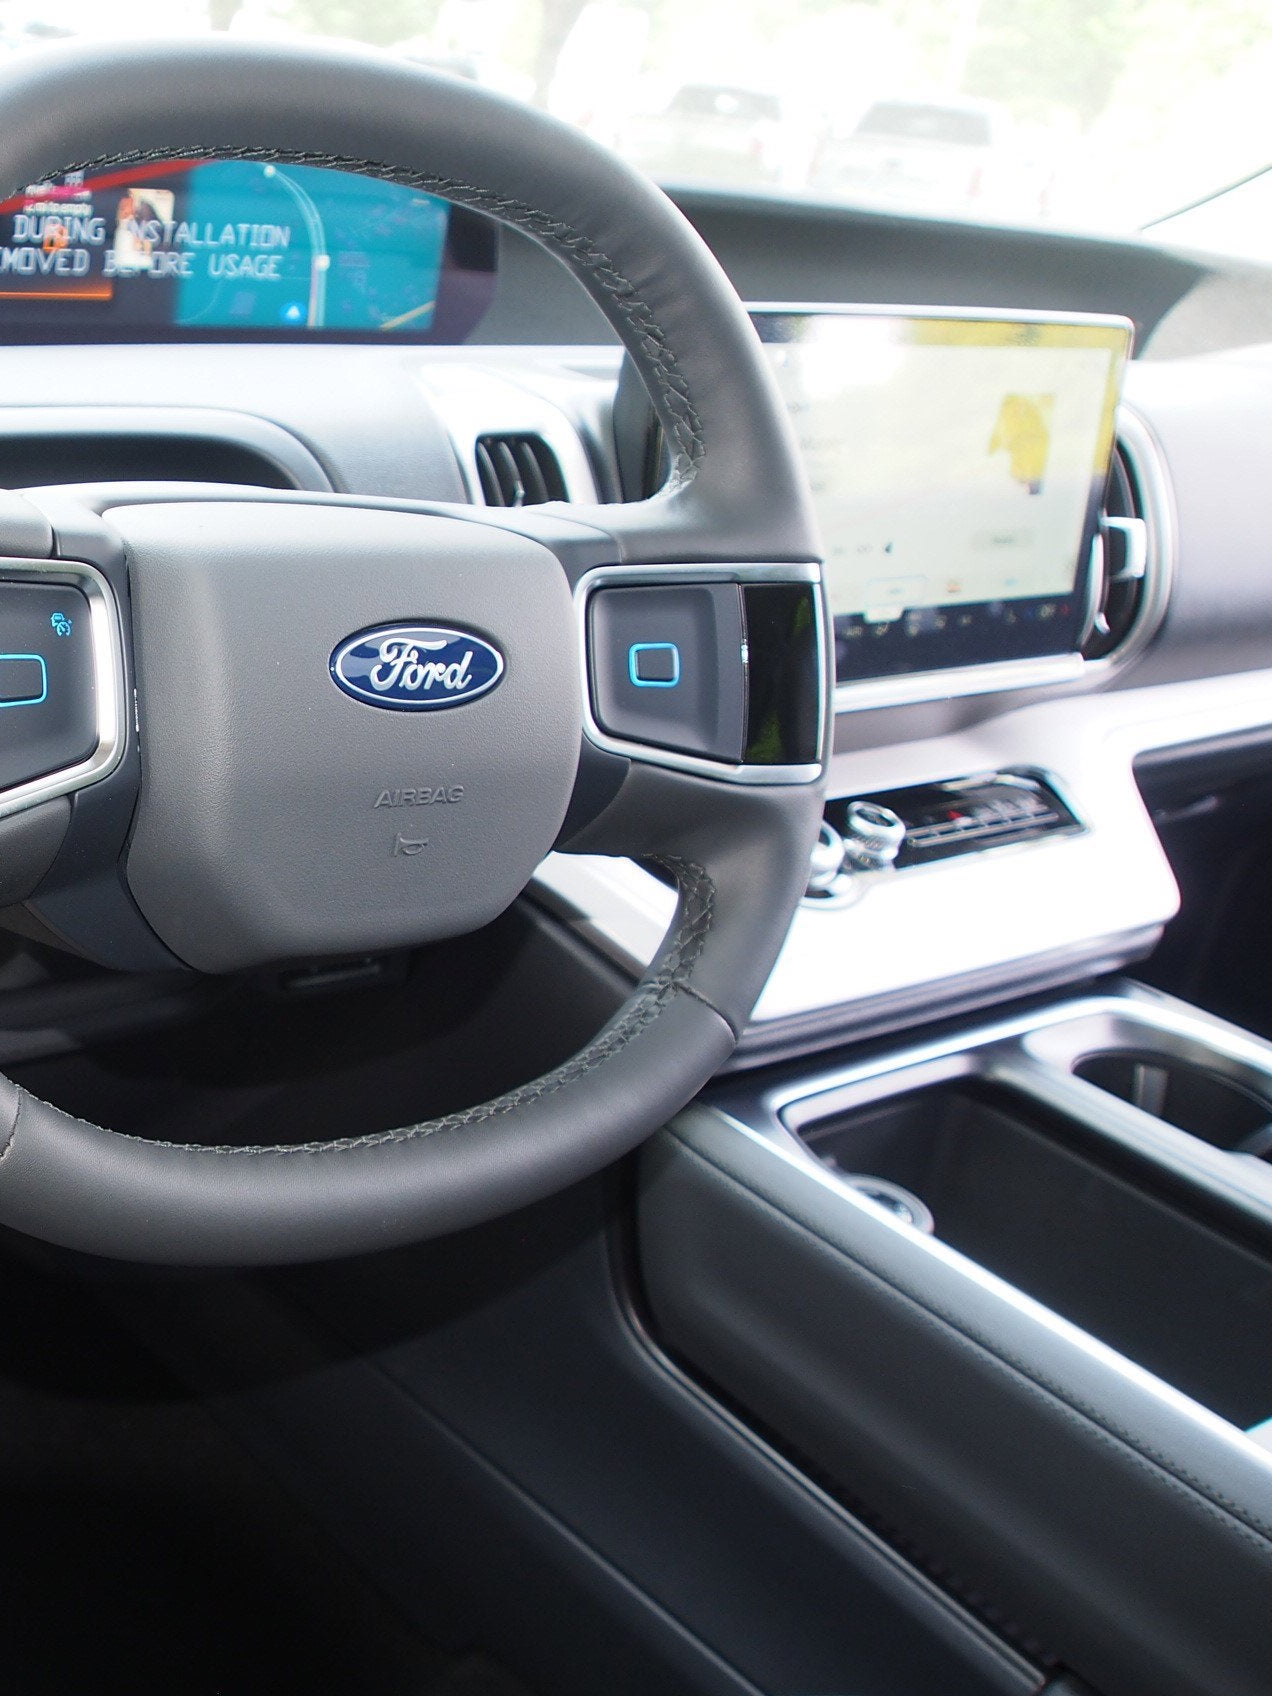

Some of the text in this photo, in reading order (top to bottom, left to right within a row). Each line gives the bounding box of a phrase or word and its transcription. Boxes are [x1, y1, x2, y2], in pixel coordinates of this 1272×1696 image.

[13, 215, 106, 246] DURING
[122, 219, 290, 248] NSTALLATION
[103, 250, 195, 277] BEORE
[208, 253, 283, 279] USAGE
[370, 637, 473, 690] Ford
[374, 785, 465, 809] AIRBAG
